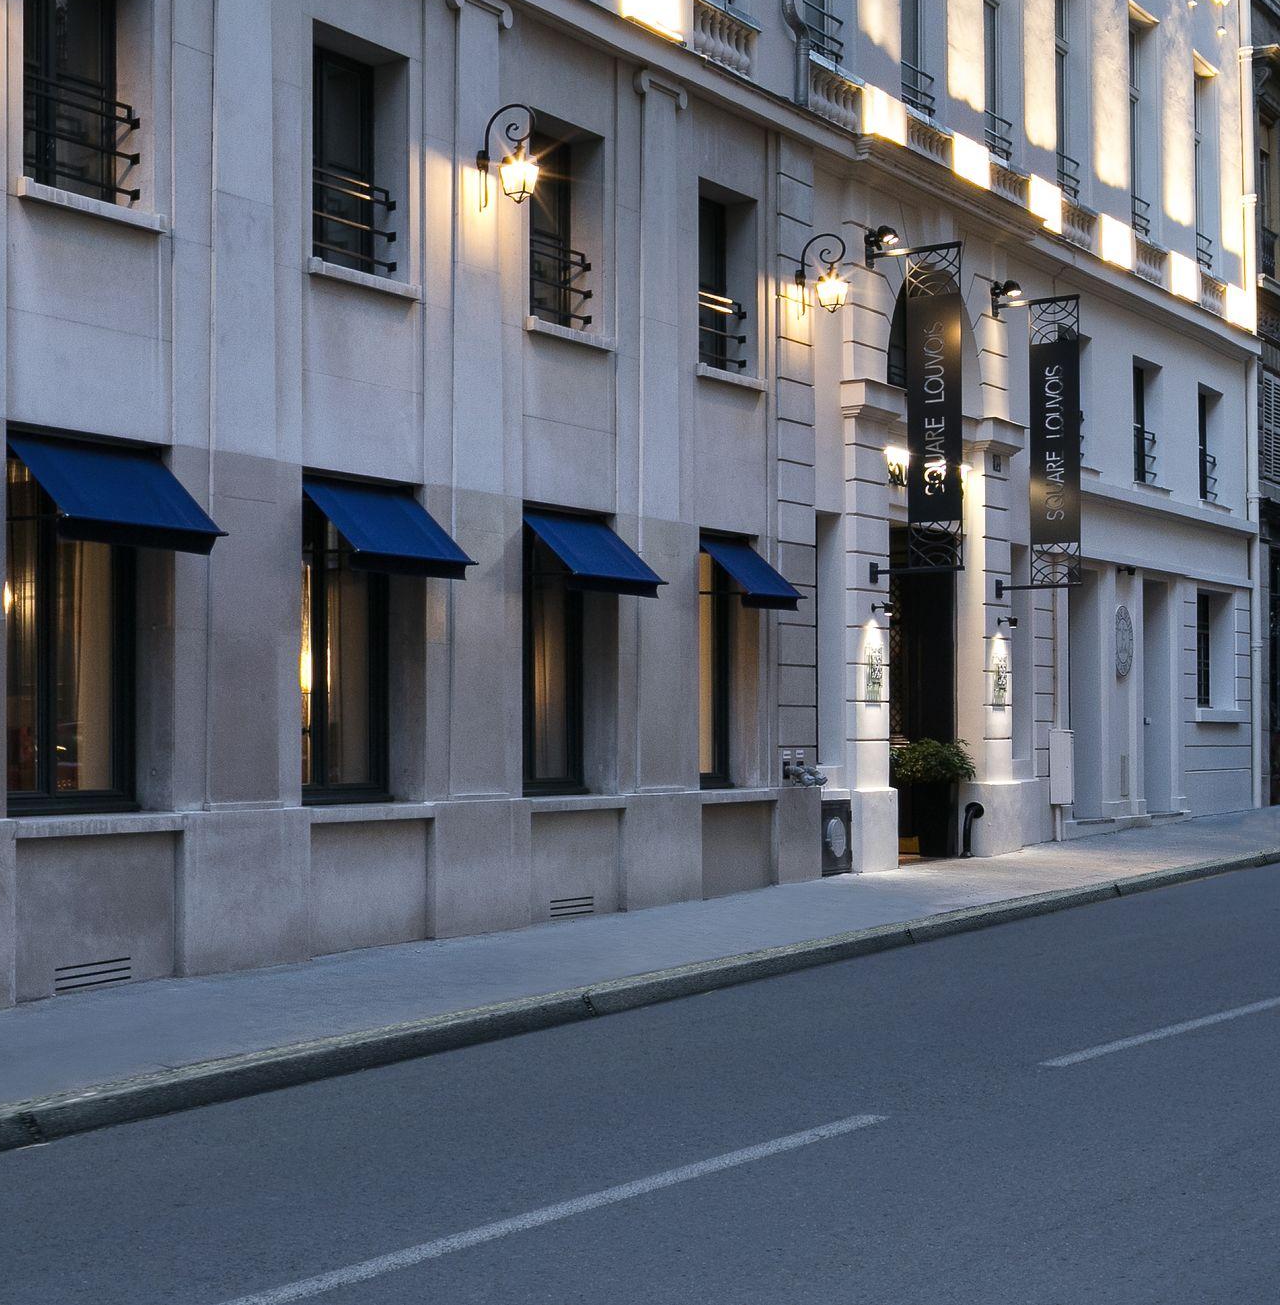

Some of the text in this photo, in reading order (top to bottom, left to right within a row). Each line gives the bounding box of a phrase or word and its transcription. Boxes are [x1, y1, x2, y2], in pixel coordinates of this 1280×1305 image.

[923, 320, 947, 496] SQUARE LOUVOIS
[1045, 364, 1065, 521] SQUARE LOUVOIS
